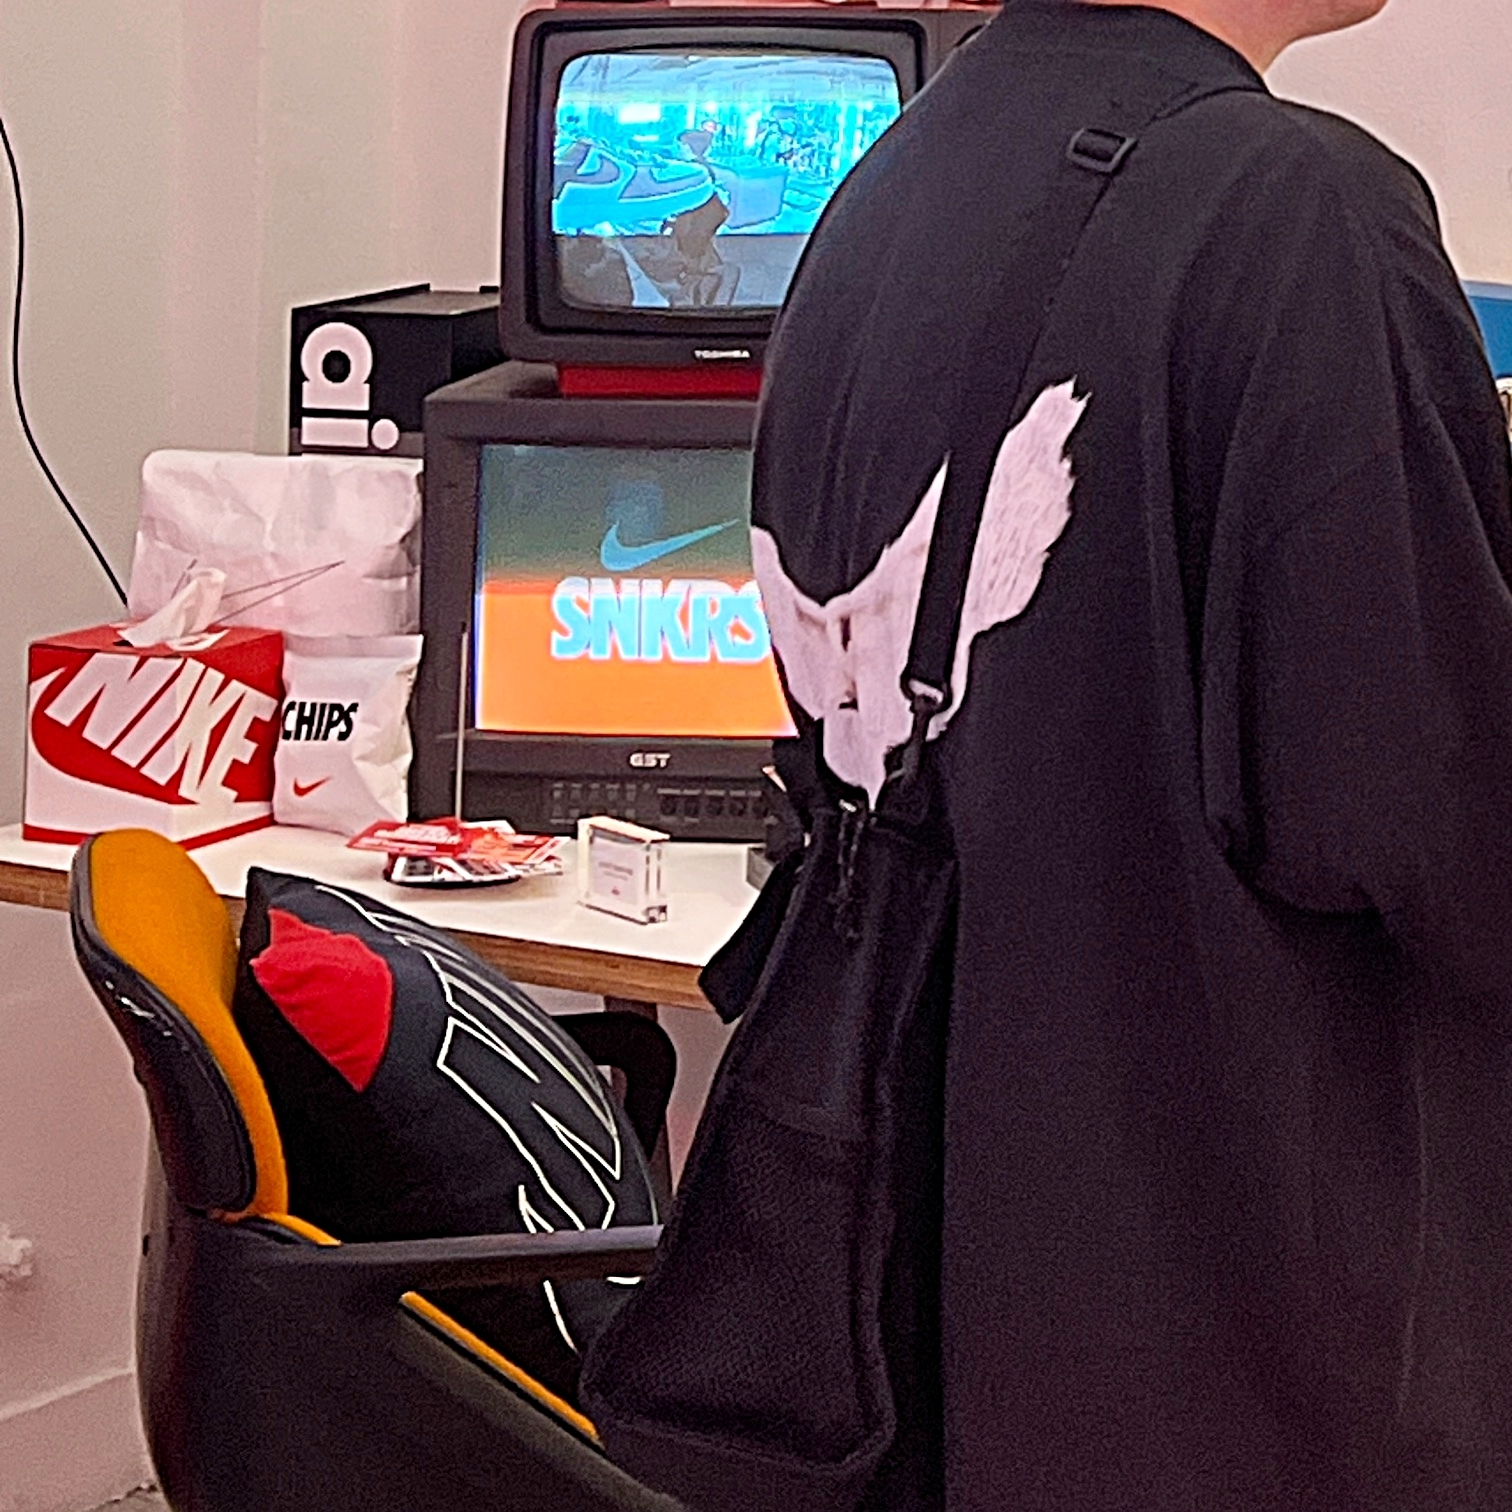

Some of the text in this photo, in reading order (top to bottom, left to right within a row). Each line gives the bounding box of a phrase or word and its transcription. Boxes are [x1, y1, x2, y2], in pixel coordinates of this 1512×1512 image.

[550, 576, 772, 663] SNKRS
[44, 652, 279, 805] NIKE
[281, 701, 359, 742] CHIPS
